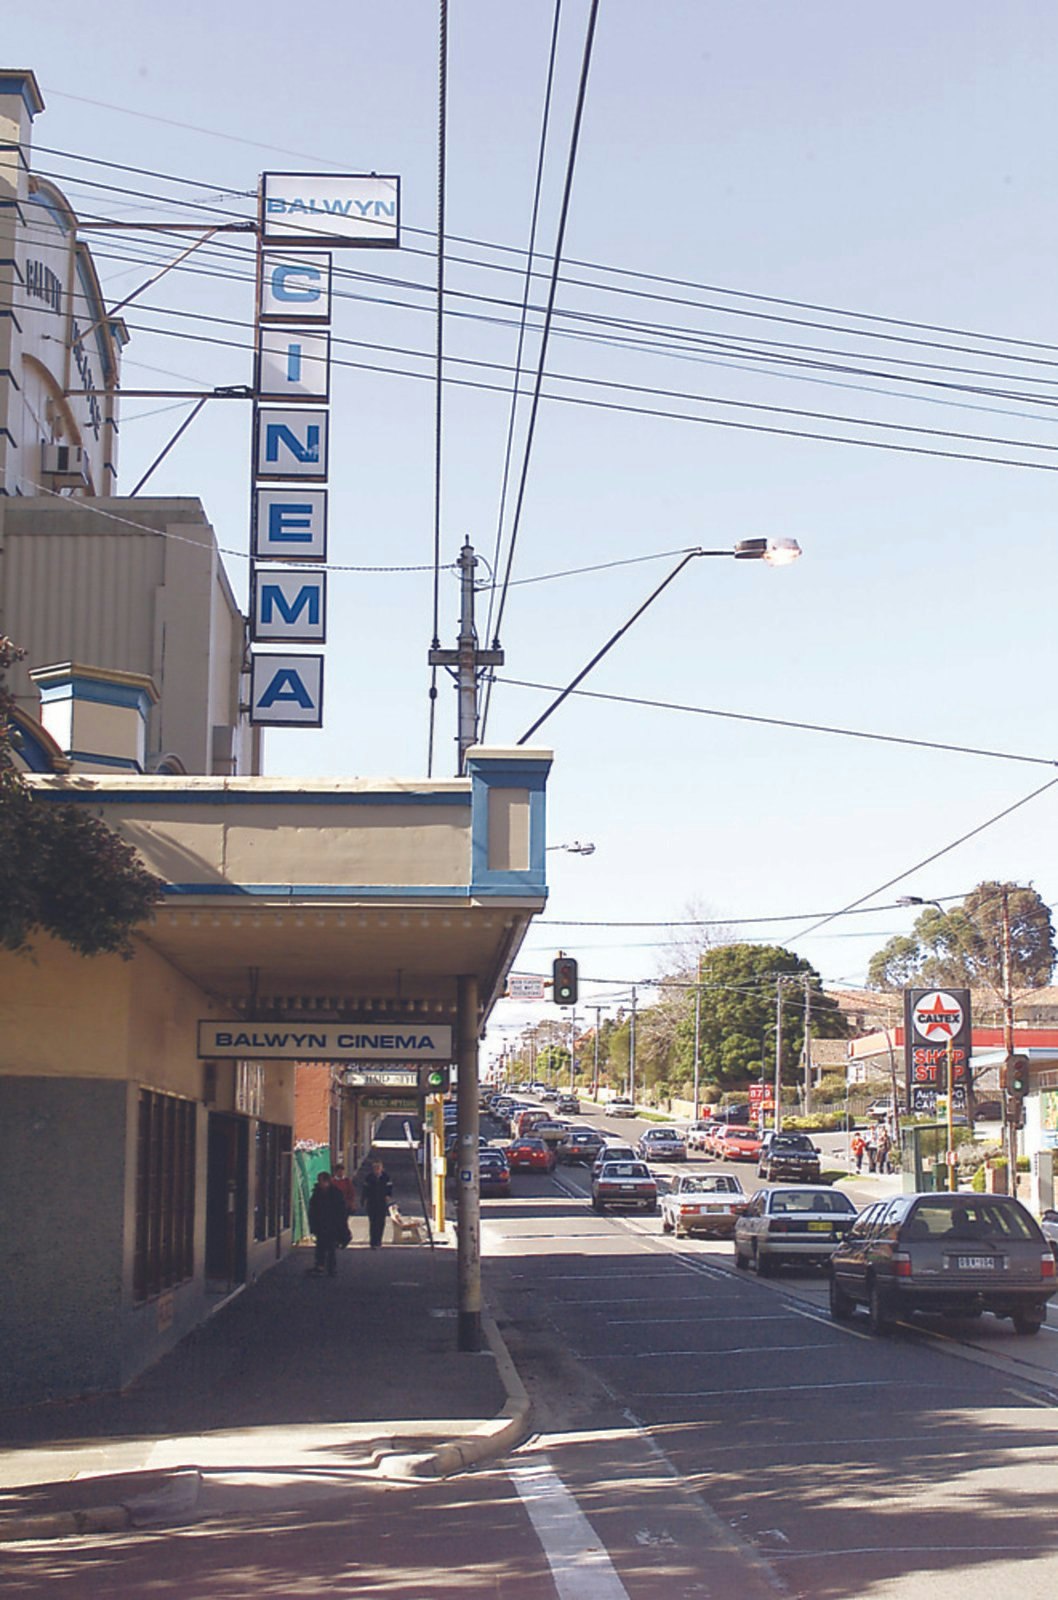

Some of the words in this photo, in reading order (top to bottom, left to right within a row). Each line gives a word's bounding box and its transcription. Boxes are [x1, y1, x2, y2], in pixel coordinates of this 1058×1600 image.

[266, 198, 396, 217] BALWYN
[917, 1013, 960, 1024] CALTEX
[215, 1033, 326, 1048] BALWYN
[337, 1034, 435, 1050] CINEMA
[915, 1049, 965, 1065] SHP
[916, 1065, 964, 1081] STP
